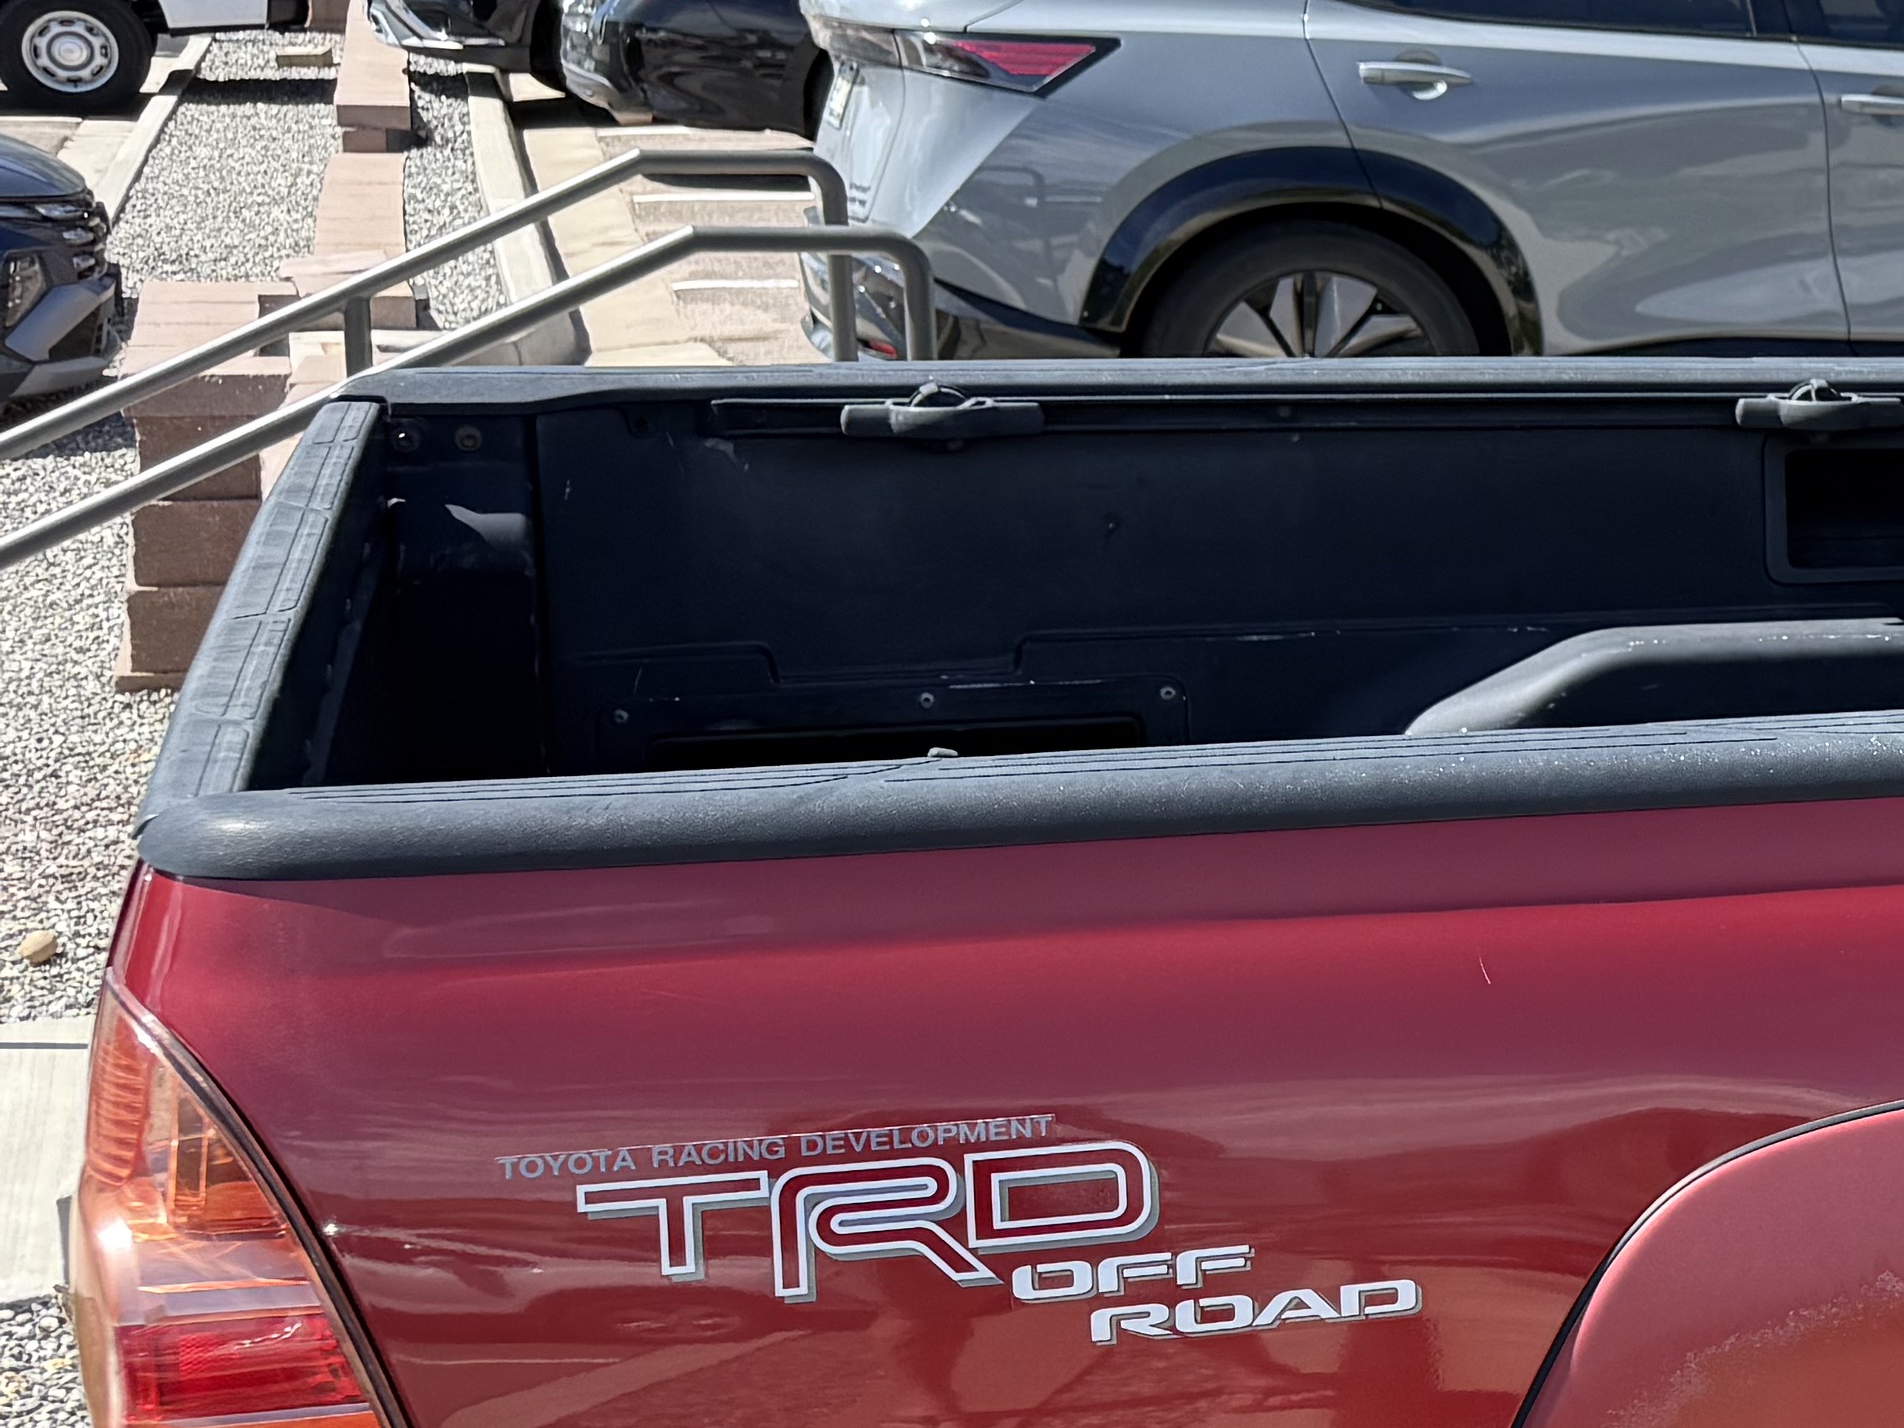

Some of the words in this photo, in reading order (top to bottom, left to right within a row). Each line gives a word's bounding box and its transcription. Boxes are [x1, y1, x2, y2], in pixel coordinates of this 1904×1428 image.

[497, 1149, 636, 1180] TOYOTA
[652, 1136, 785, 1167] RACING
[800, 1114, 1055, 1155] DEVELOPMENT
[576, 1140, 1160, 1300] TRD
[1011, 1244, 1256, 1305] OFF
[1089, 1278, 1422, 1346] ROAD
